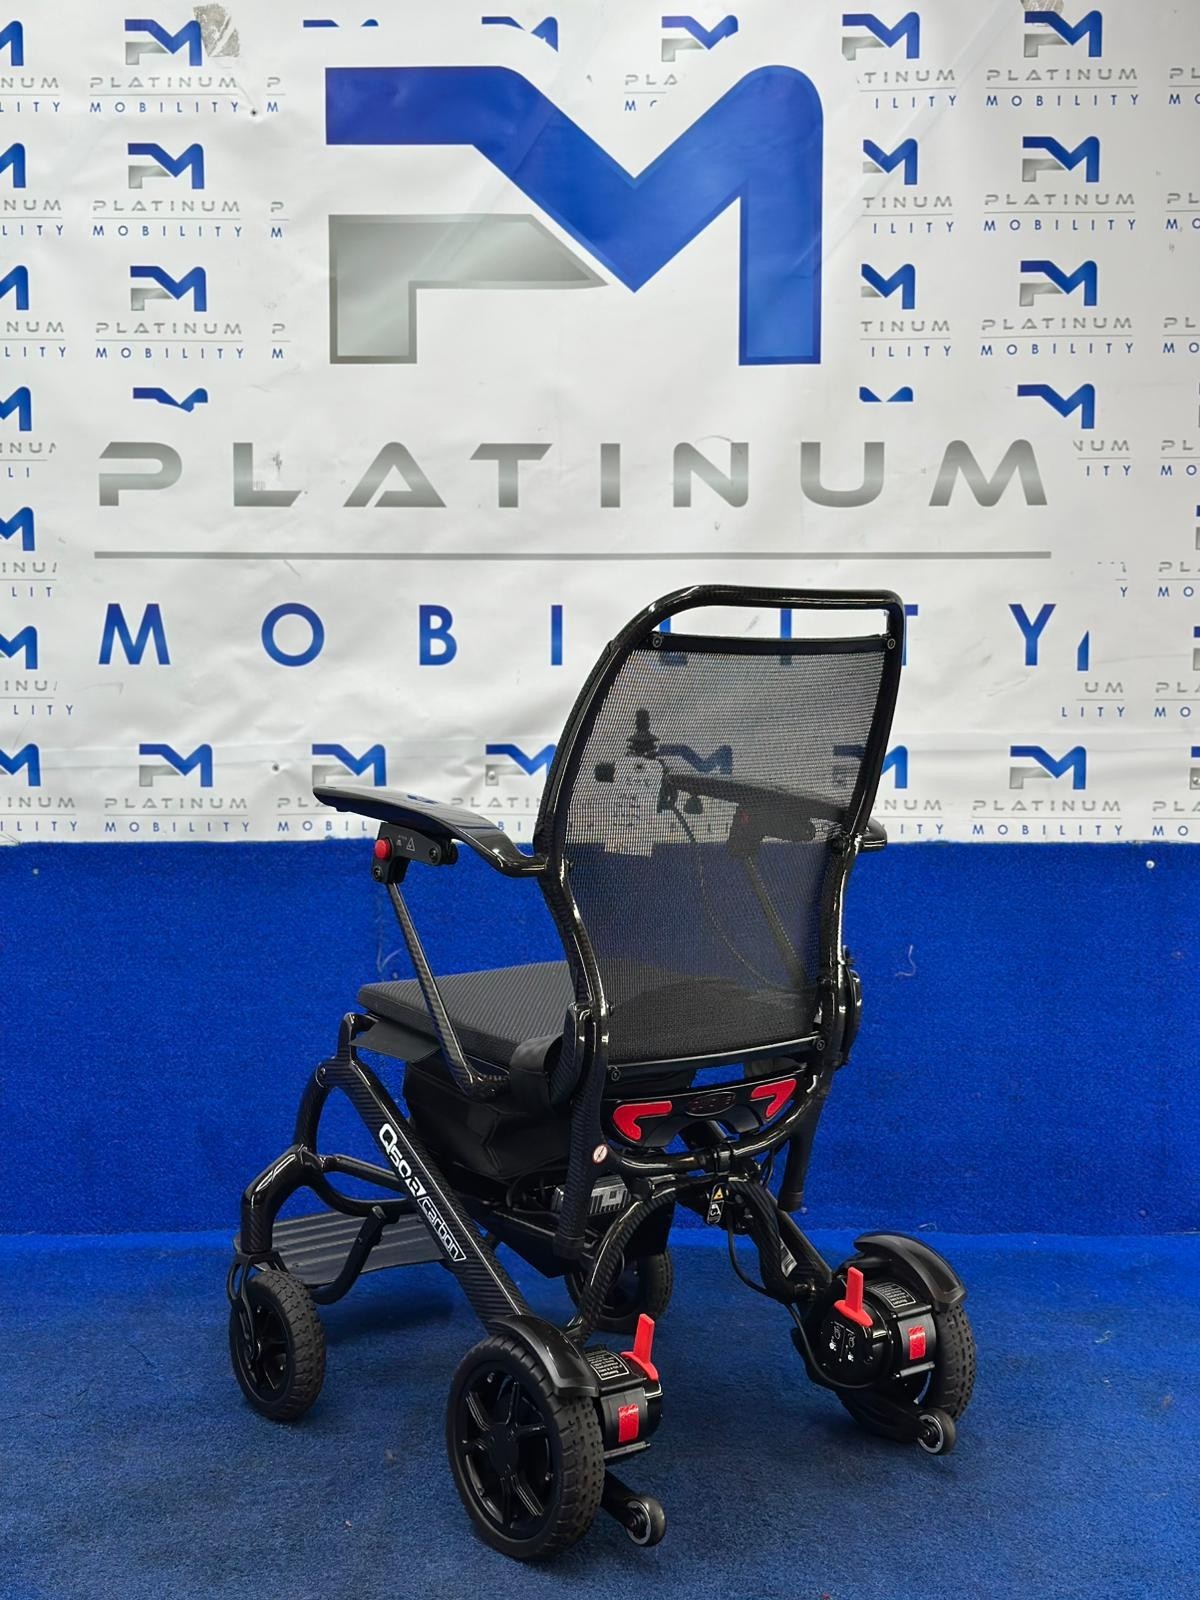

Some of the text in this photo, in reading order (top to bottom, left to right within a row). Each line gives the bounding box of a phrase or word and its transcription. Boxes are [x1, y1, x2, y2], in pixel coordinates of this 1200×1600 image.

[857, 69, 955, 83] TINUM
[987, 68, 1137, 81] PLATINUM
[90, 77, 237, 88] PLATINUM
[986, 94, 1138, 106] MOBILITY
[90, 102, 238, 113] MOBILITY
[985, 193, 1134, 205] PLATINUM
[93, 200, 239, 212] PLATINUM
[93, 225, 241, 237] MOBILITY
[984, 219, 1135, 231] MOBILITY
[96, 322, 241, 334] PLATINUM
[982, 317, 1132, 330] PLATINUM
[96, 348, 243, 359] MOBILITY
[981, 343, 1133, 355] MOBILITY
[99, 439, 1047, 508] PLATINUM
[104, 798, 247, 809] PLATINUM
[973, 800, 1120, 811] PLATINUM
[105, 822, 249, 832] MOBILITY
[973, 824, 1122, 835] MOBILITY
